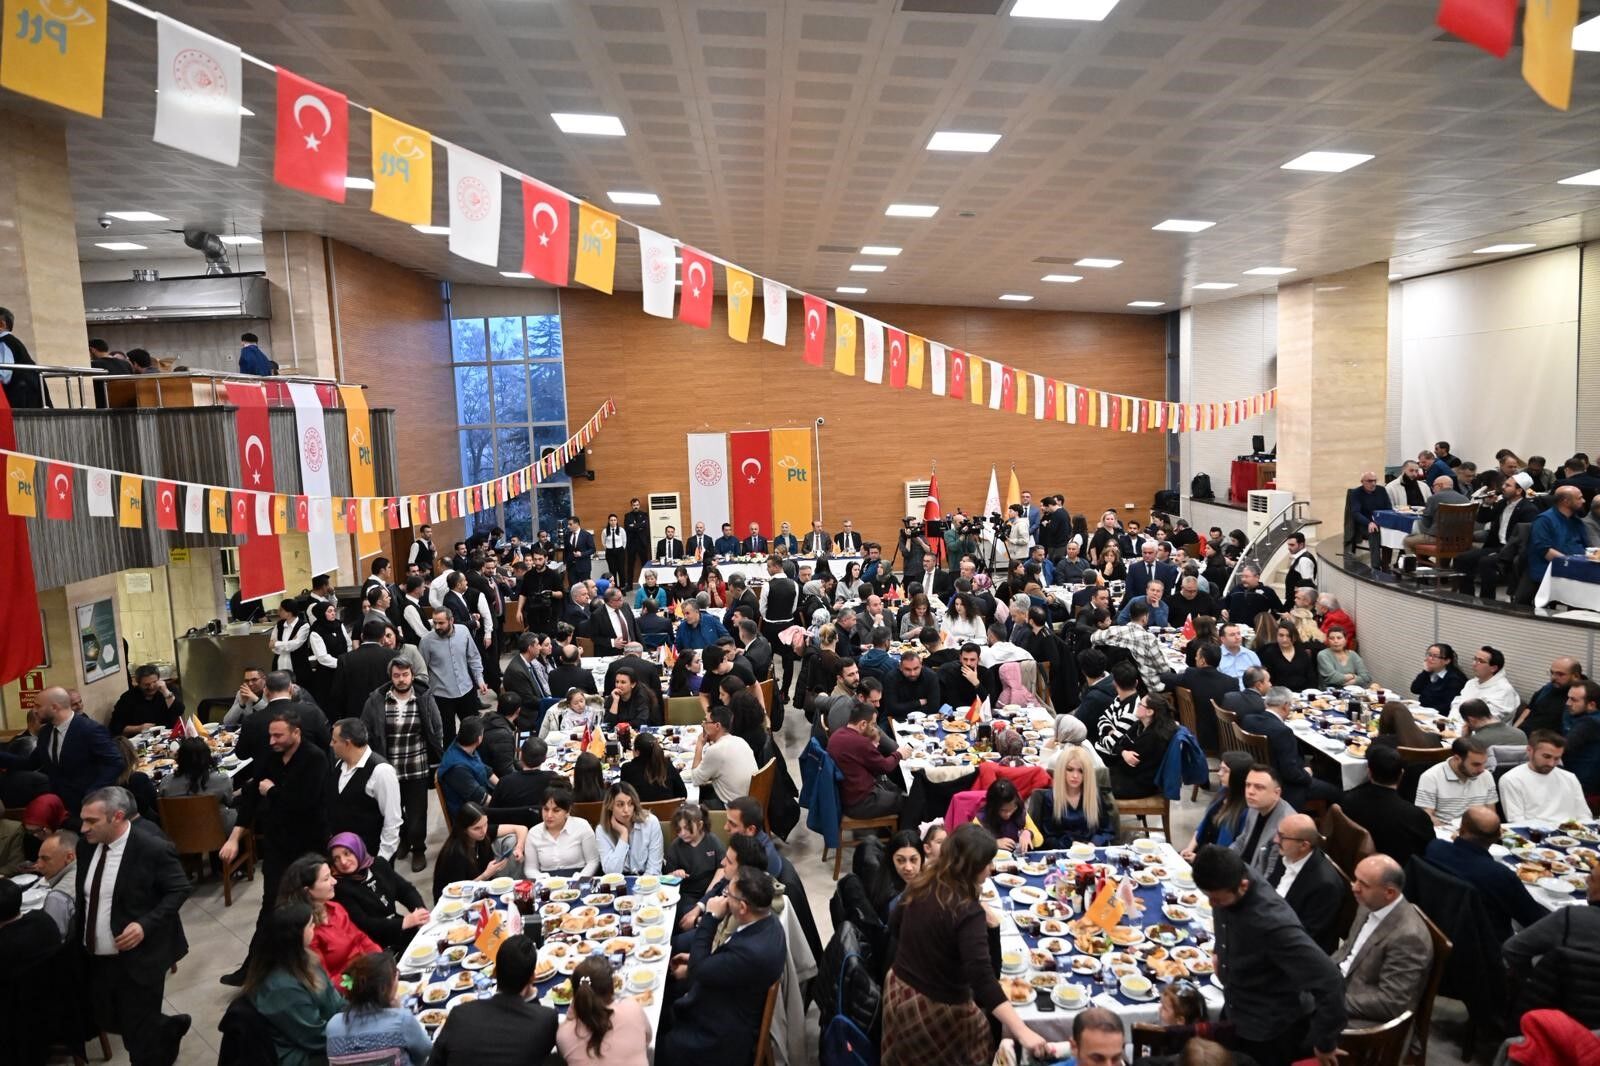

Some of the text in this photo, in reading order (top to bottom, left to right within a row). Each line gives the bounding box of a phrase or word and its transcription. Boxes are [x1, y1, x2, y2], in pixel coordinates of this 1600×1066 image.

[359, 446, 371, 465] Ptt
[787, 467, 807, 482] Ptt
[18, 481, 32, 496] Ptt
